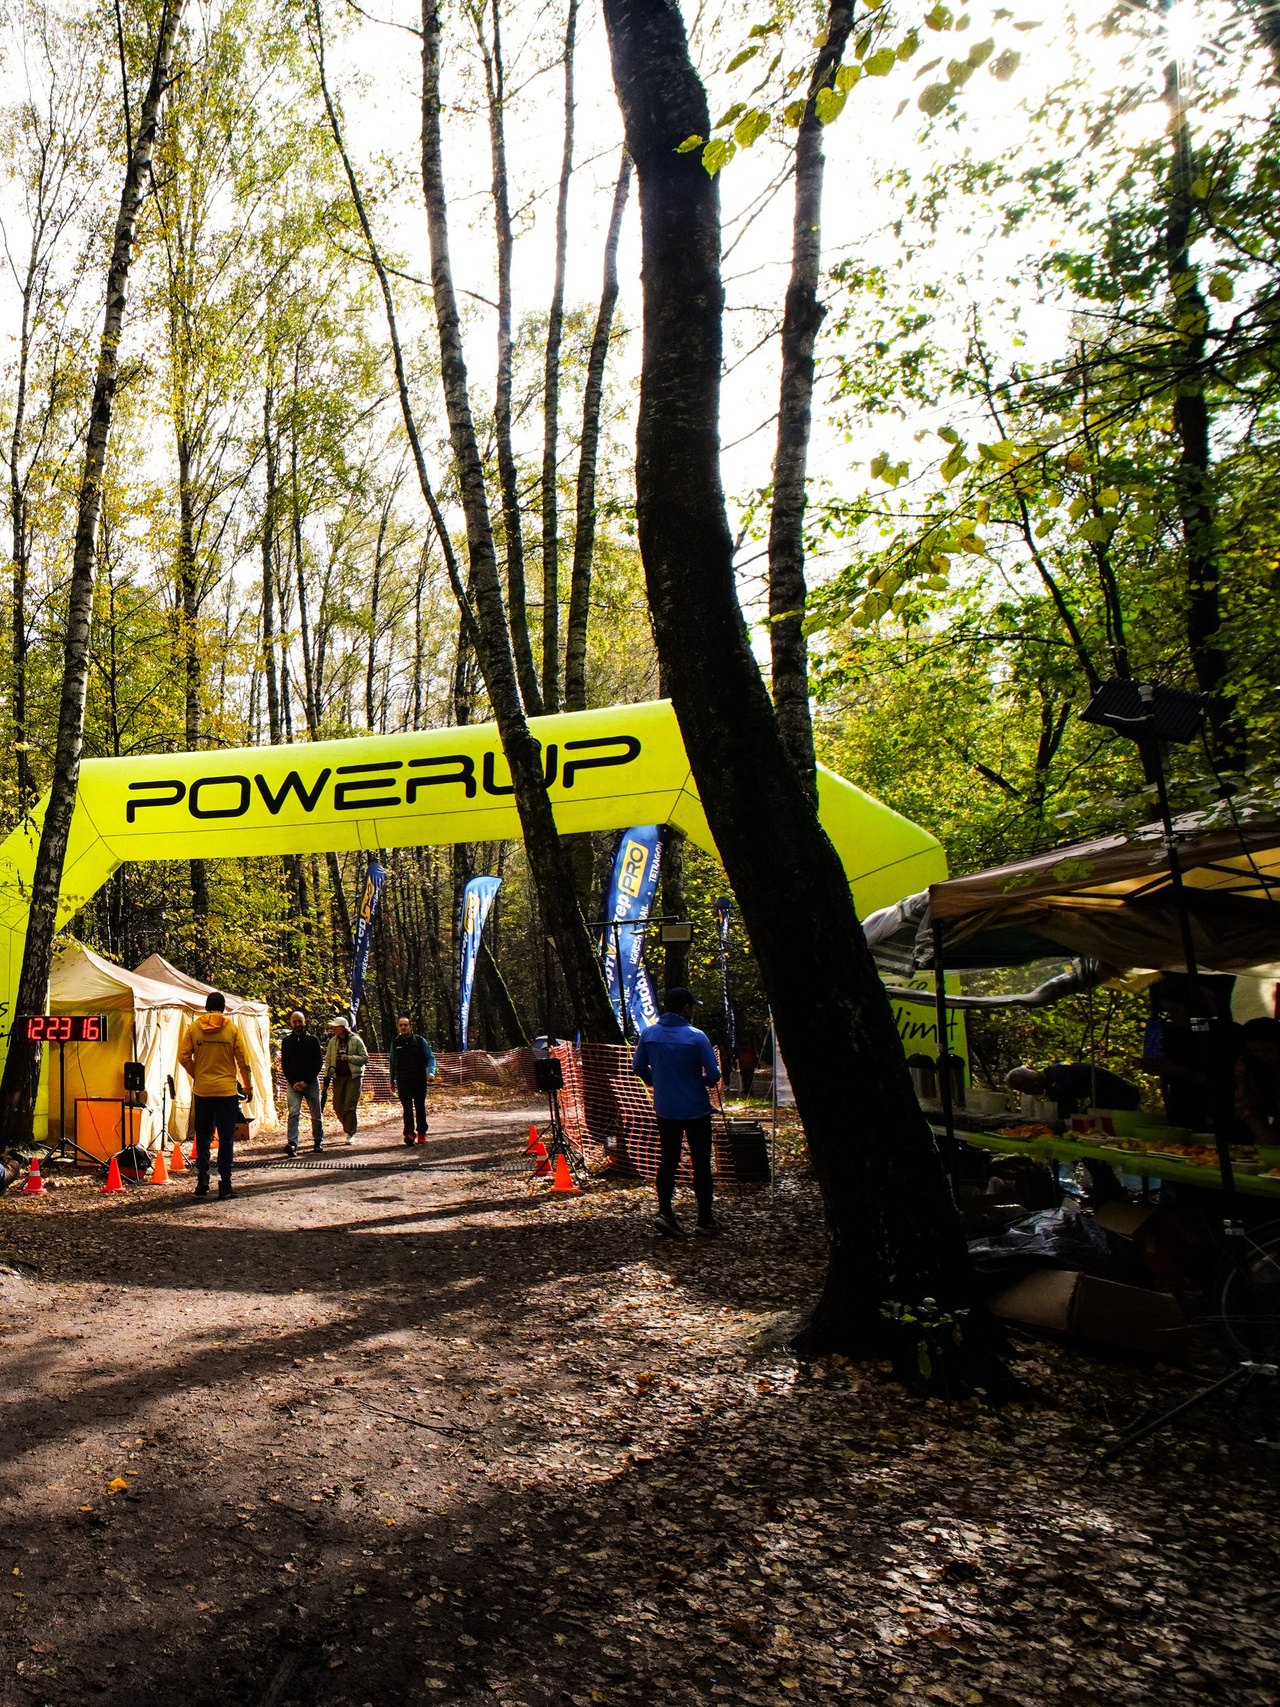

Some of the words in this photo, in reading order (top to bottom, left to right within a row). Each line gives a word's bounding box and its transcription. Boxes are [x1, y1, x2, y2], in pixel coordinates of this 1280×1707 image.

[126, 734, 642, 824] POWERUP
[621, 846, 644, 893] PRO
[648, 841, 663, 883] TETRAGON
[895, 1007, 958, 1044] limt
